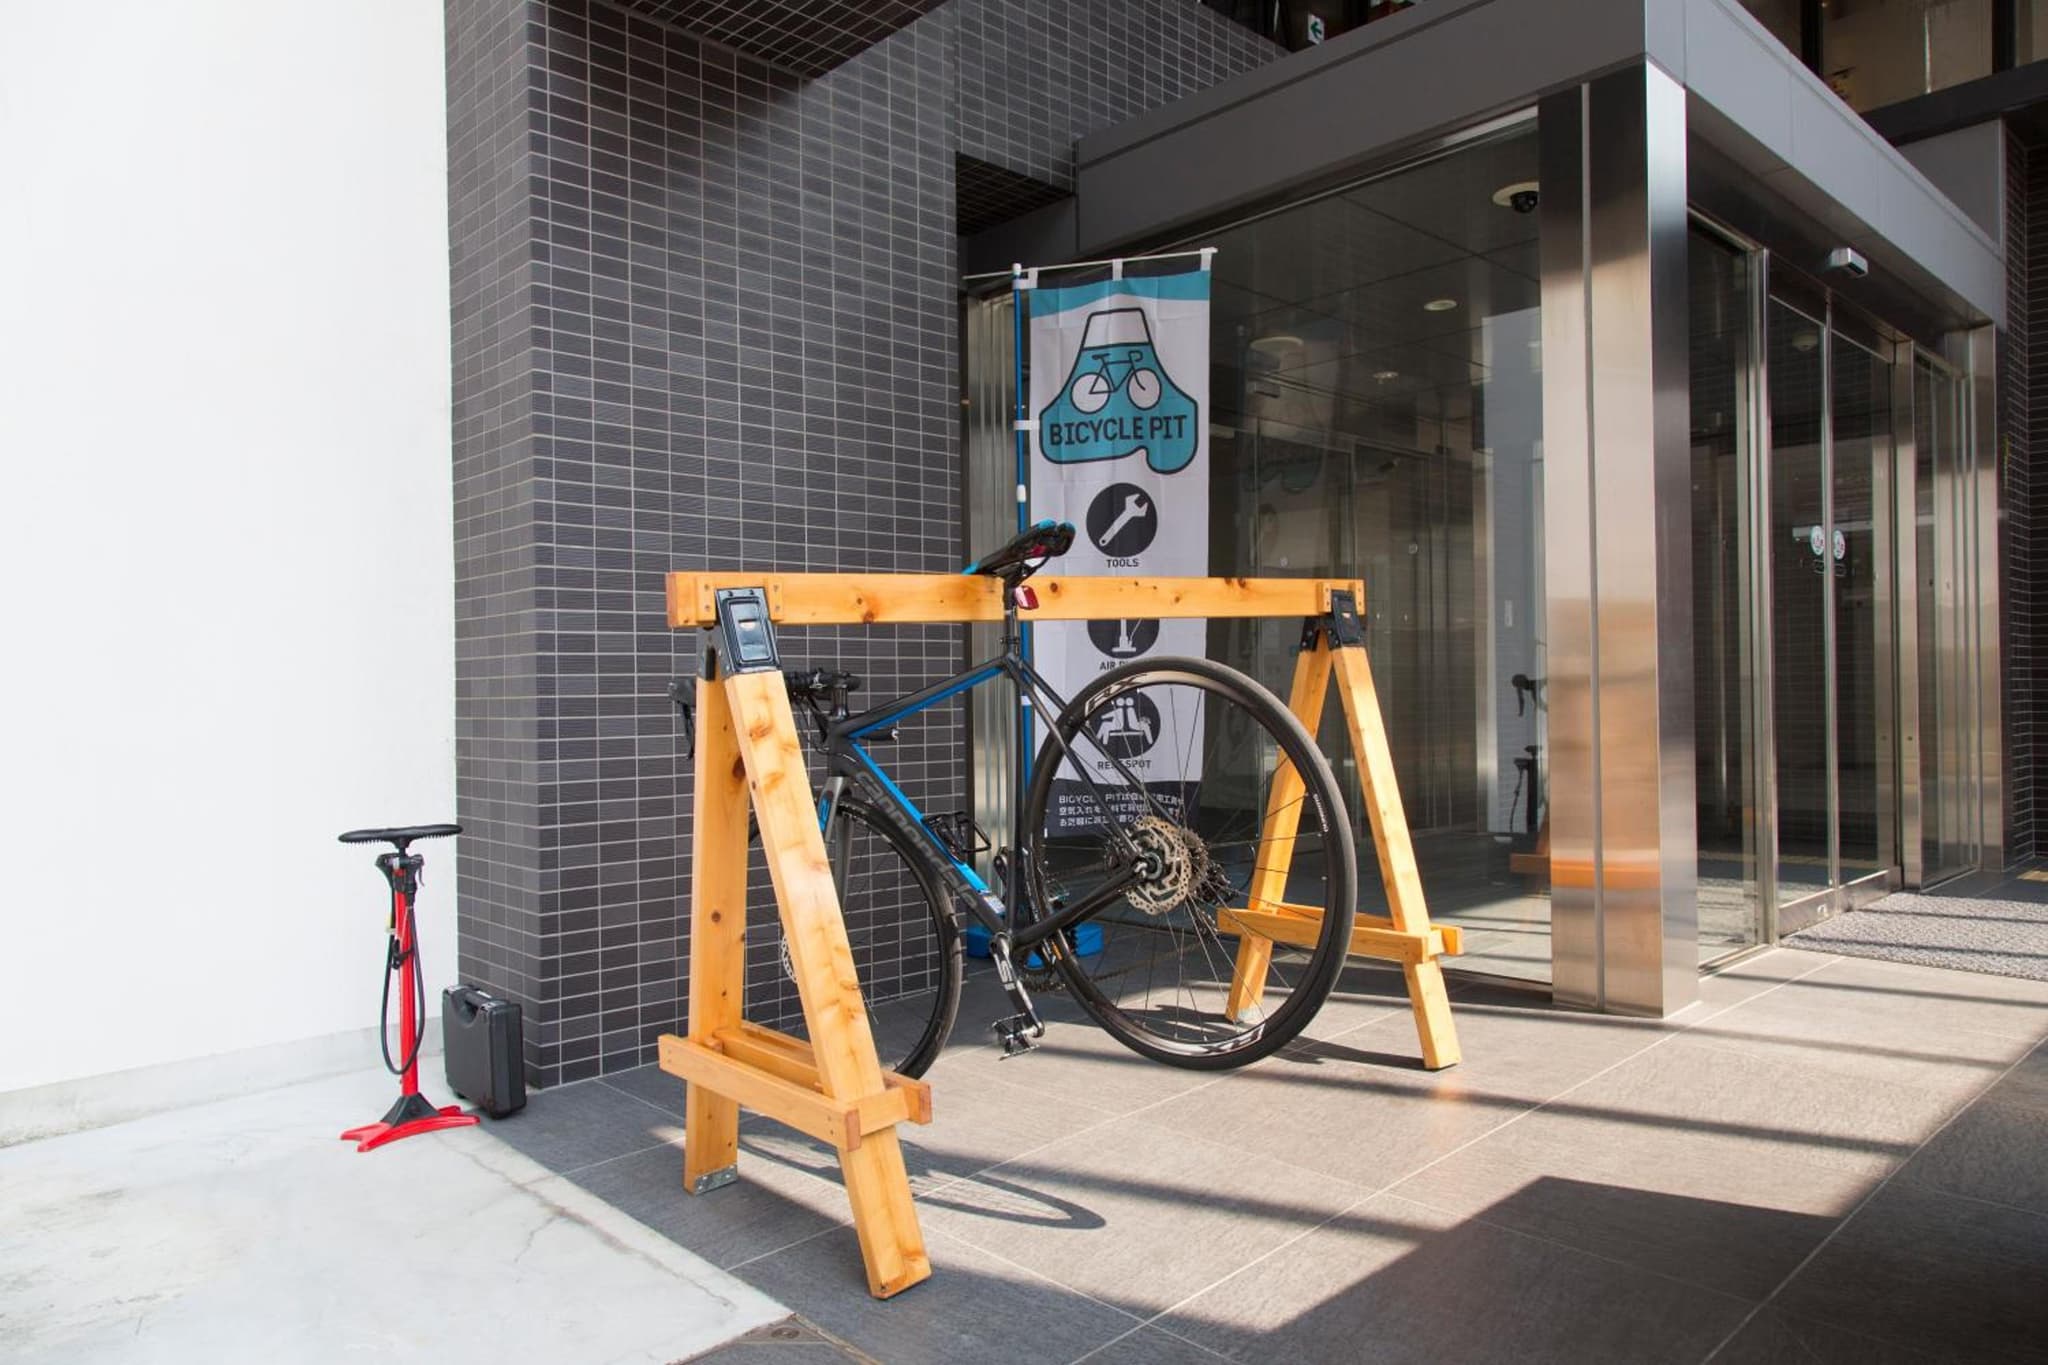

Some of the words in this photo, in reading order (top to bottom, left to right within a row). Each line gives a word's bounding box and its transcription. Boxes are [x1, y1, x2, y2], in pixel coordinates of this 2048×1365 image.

[1050, 417, 1144, 446] BICYCLE
[1149, 415, 1188, 440] PIT
[1105, 558, 1140, 569] TOOLS
[1099, 661, 1117, 671] AIR
[1125, 760, 1152, 770] SPOT
[1059, 794, 1101, 804] BICYCL
